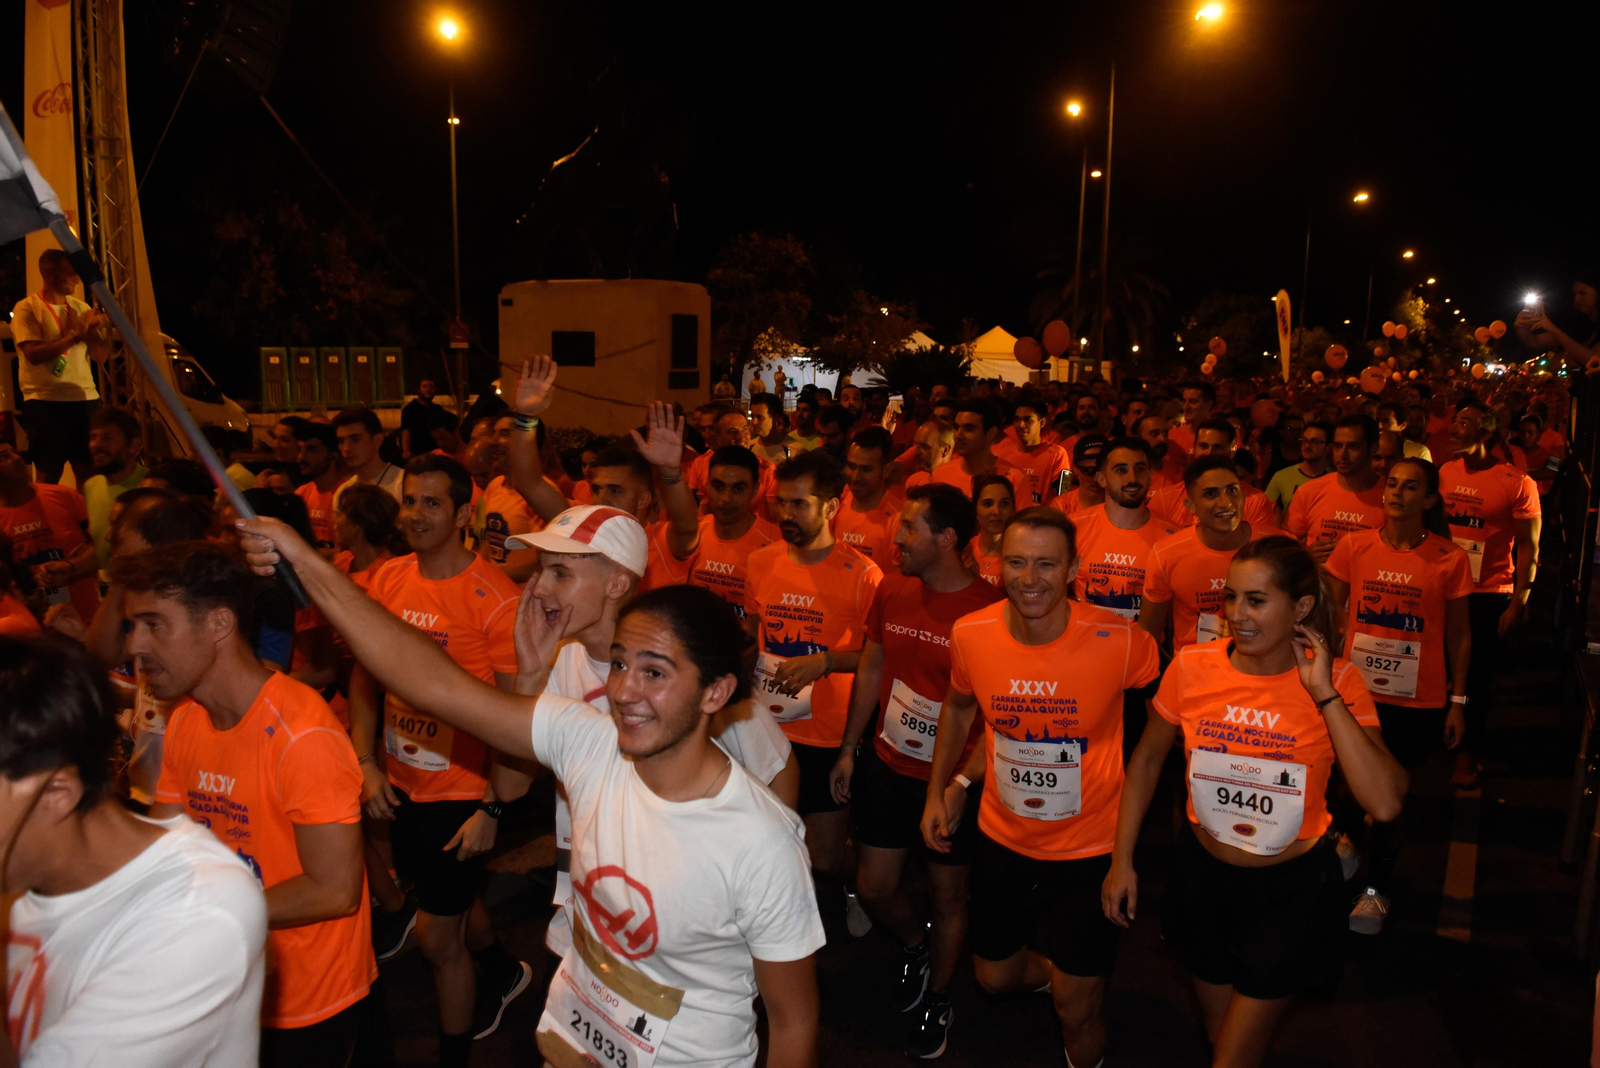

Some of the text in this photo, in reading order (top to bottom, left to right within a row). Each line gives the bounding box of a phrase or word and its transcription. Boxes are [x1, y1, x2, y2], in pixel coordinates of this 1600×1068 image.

[1455, 485, 1478, 496] XXXV
[1334, 510, 1364, 523] XXXV
[13, 521, 41, 535] XXXV
[842, 532, 866, 544] XXXV
[705, 559, 736, 575] XXXV
[1103, 552, 1137, 566] XXXV
[1116, 565, 1146, 574] NOCTURNA
[1376, 569, 1413, 585] XXXV
[1210, 578, 1227, 590] XX
[1390, 583, 1423, 593] NOCTURNA
[780, 592, 815, 608] XXXV
[402, 608, 440, 629] XXXV
[766, 604, 824, 617] CARRERA NOCTURNA
[768, 610, 824, 625] GUADALQUIVIR
[885, 622, 918, 638] sopra
[1365, 655, 1402, 672] 9527
[1009, 678, 1059, 697] XXXV
[991, 694, 1078, 706] CARRERA NOCTURNA
[995, 703, 1079, 715] GUADALQUIVIR
[391, 712, 438, 738] 14070
[900, 711, 938, 737] 5898
[1223, 704, 1281, 731] XXXV
[1199, 719, 1298, 744] CARRERA NOCTURNA
[1202, 727, 1297, 749] GUADALQUIVIR
[197, 768, 237, 797] XXXV
[1010, 767, 1058, 789] 9439
[1216, 786, 1274, 815] 9440
[570, 1009, 628, 1068] 21833
